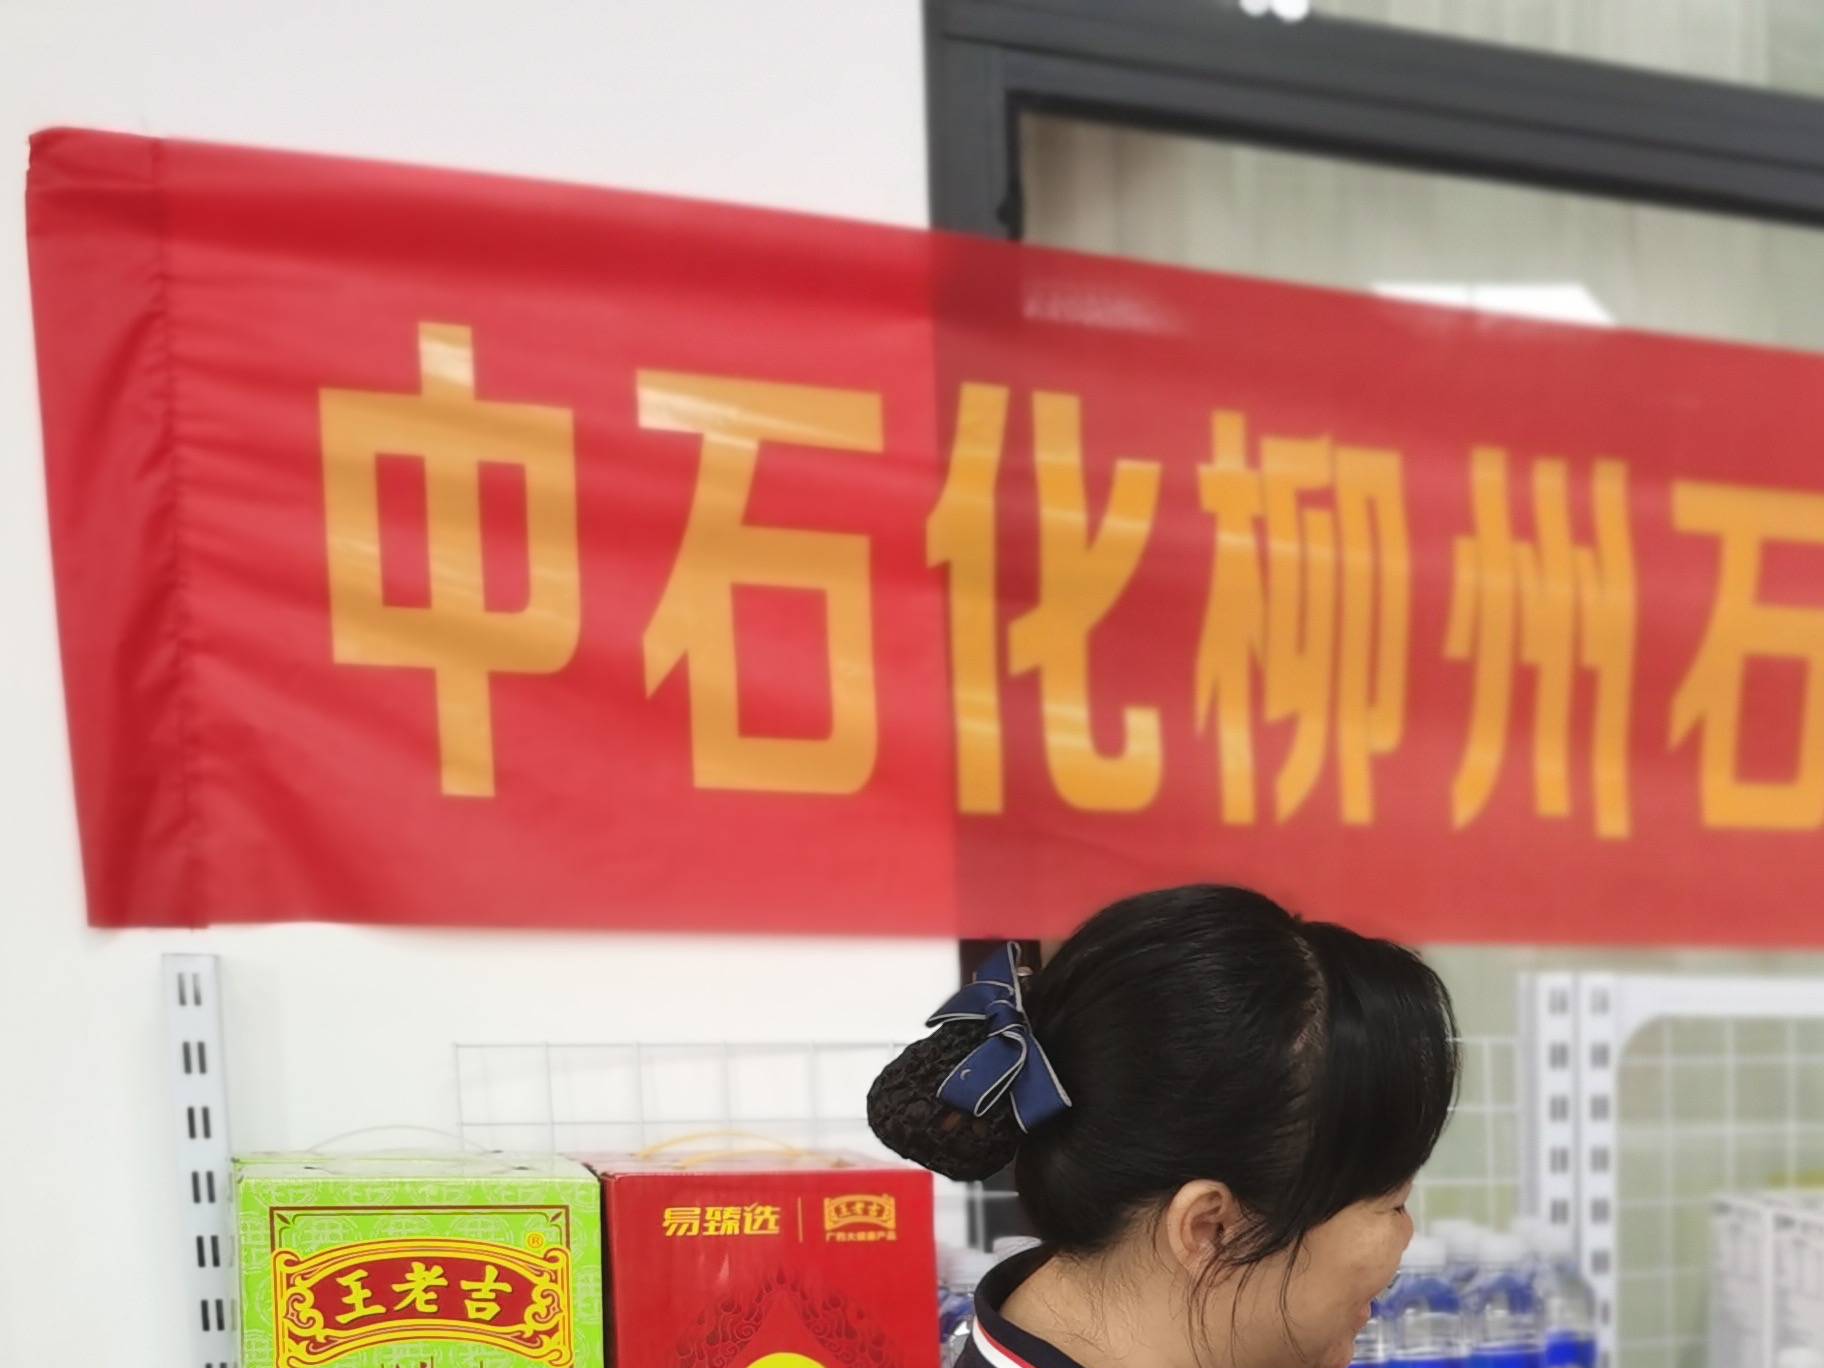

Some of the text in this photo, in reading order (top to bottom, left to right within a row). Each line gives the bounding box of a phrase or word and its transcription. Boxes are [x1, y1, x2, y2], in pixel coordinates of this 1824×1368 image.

[662, 1202, 781, 1237] 易臻选
[335, 1261, 513, 1324] 王老吉
